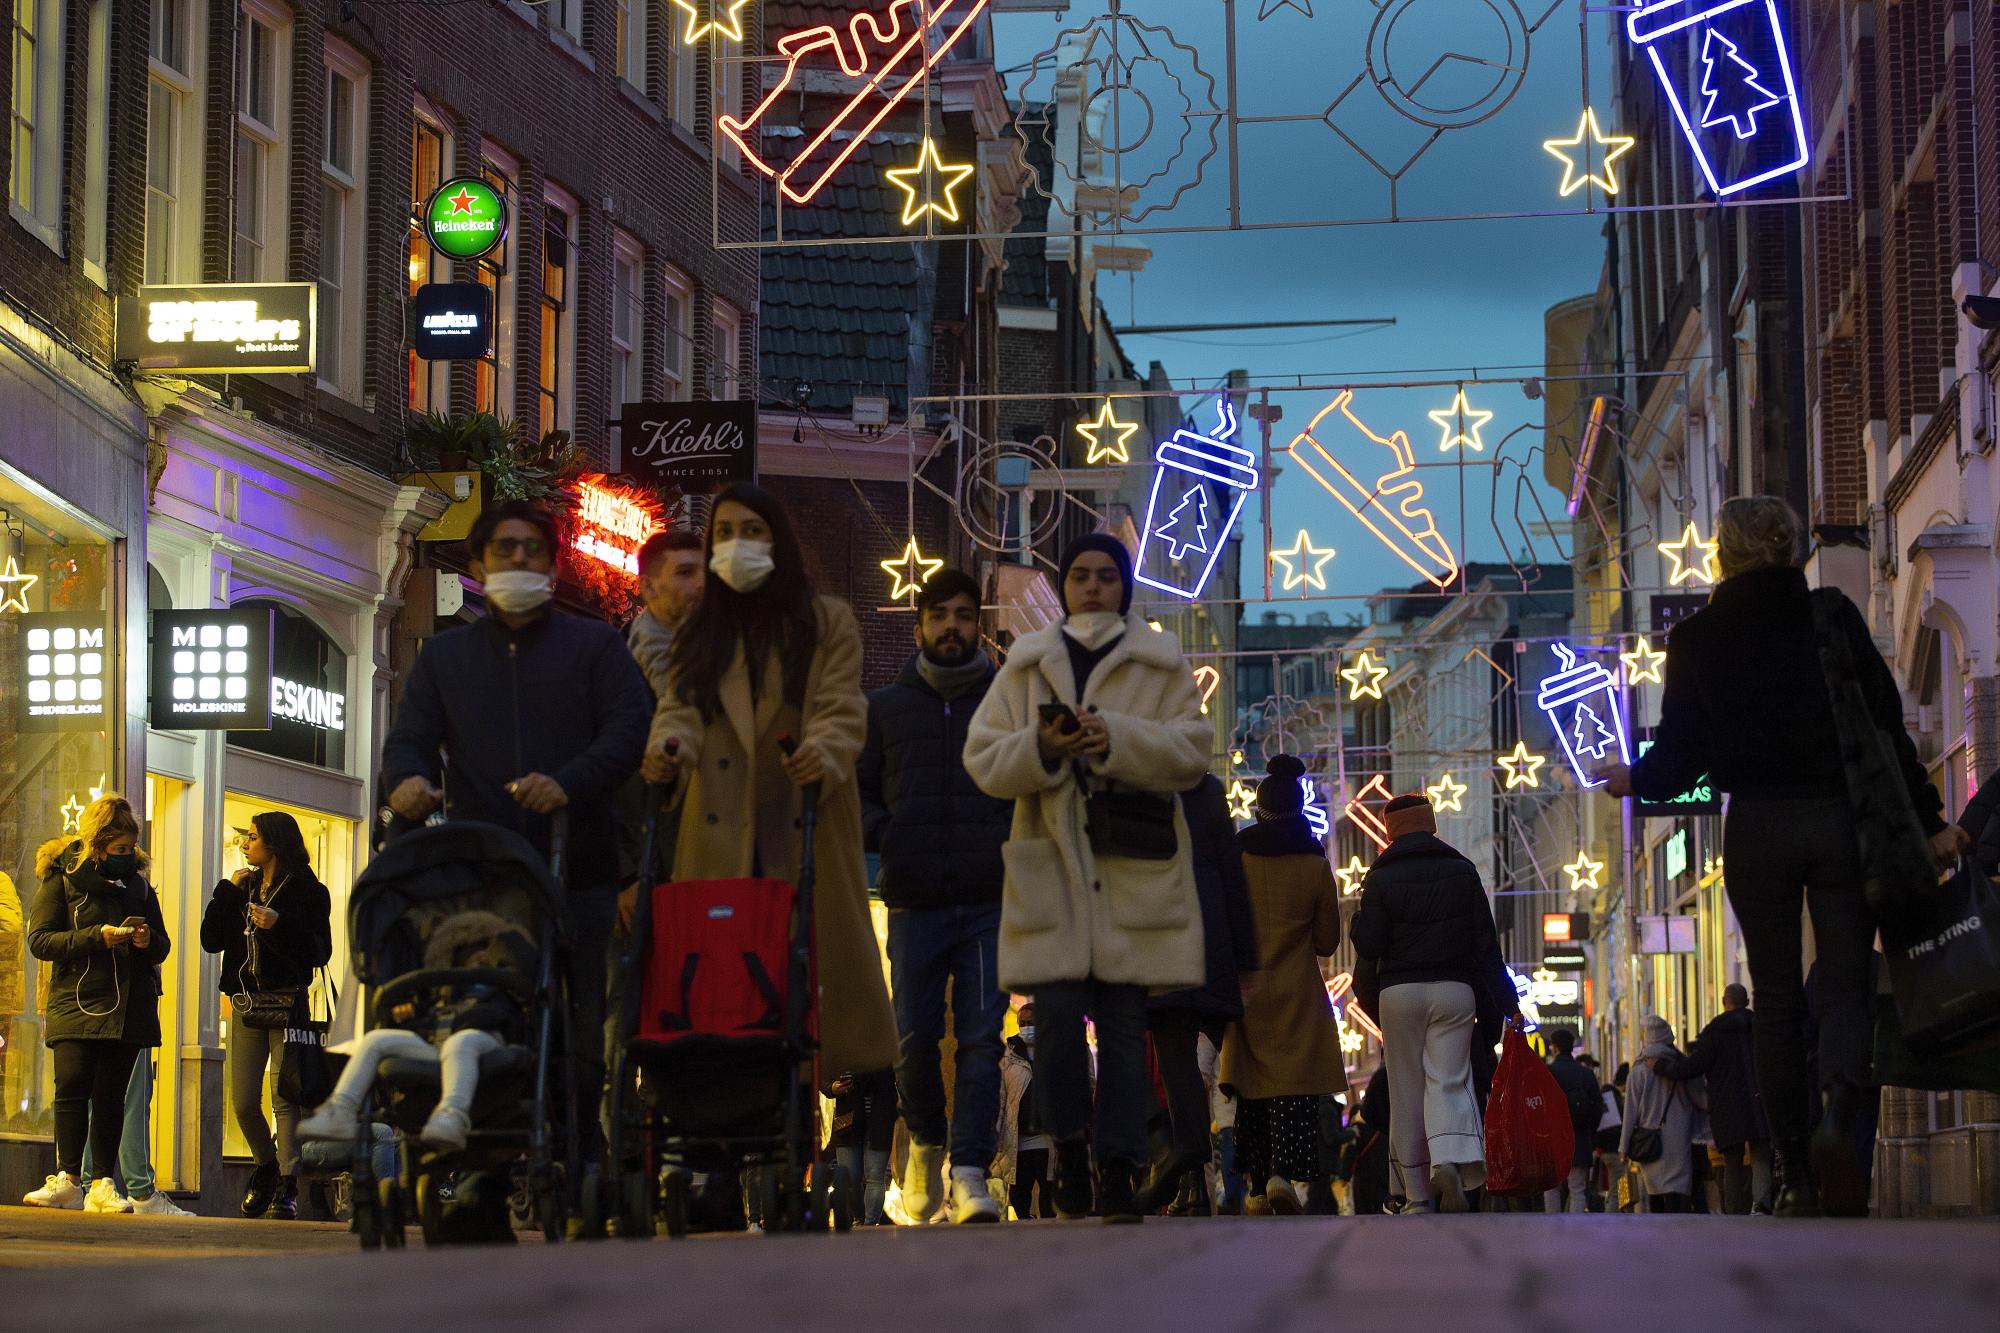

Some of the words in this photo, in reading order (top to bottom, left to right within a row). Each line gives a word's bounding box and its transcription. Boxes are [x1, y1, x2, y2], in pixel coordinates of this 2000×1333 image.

[434, 219, 495, 233] Heineken
[632, 418, 744, 456] Kiehl's
[659, 469, 695, 477] SINCE
[172, 702, 247, 713] MOLESKINE
[271, 676, 345, 731] ESKINE
[1907, 940, 1935, 960] THE
[1938, 916, 1981, 947] STING
